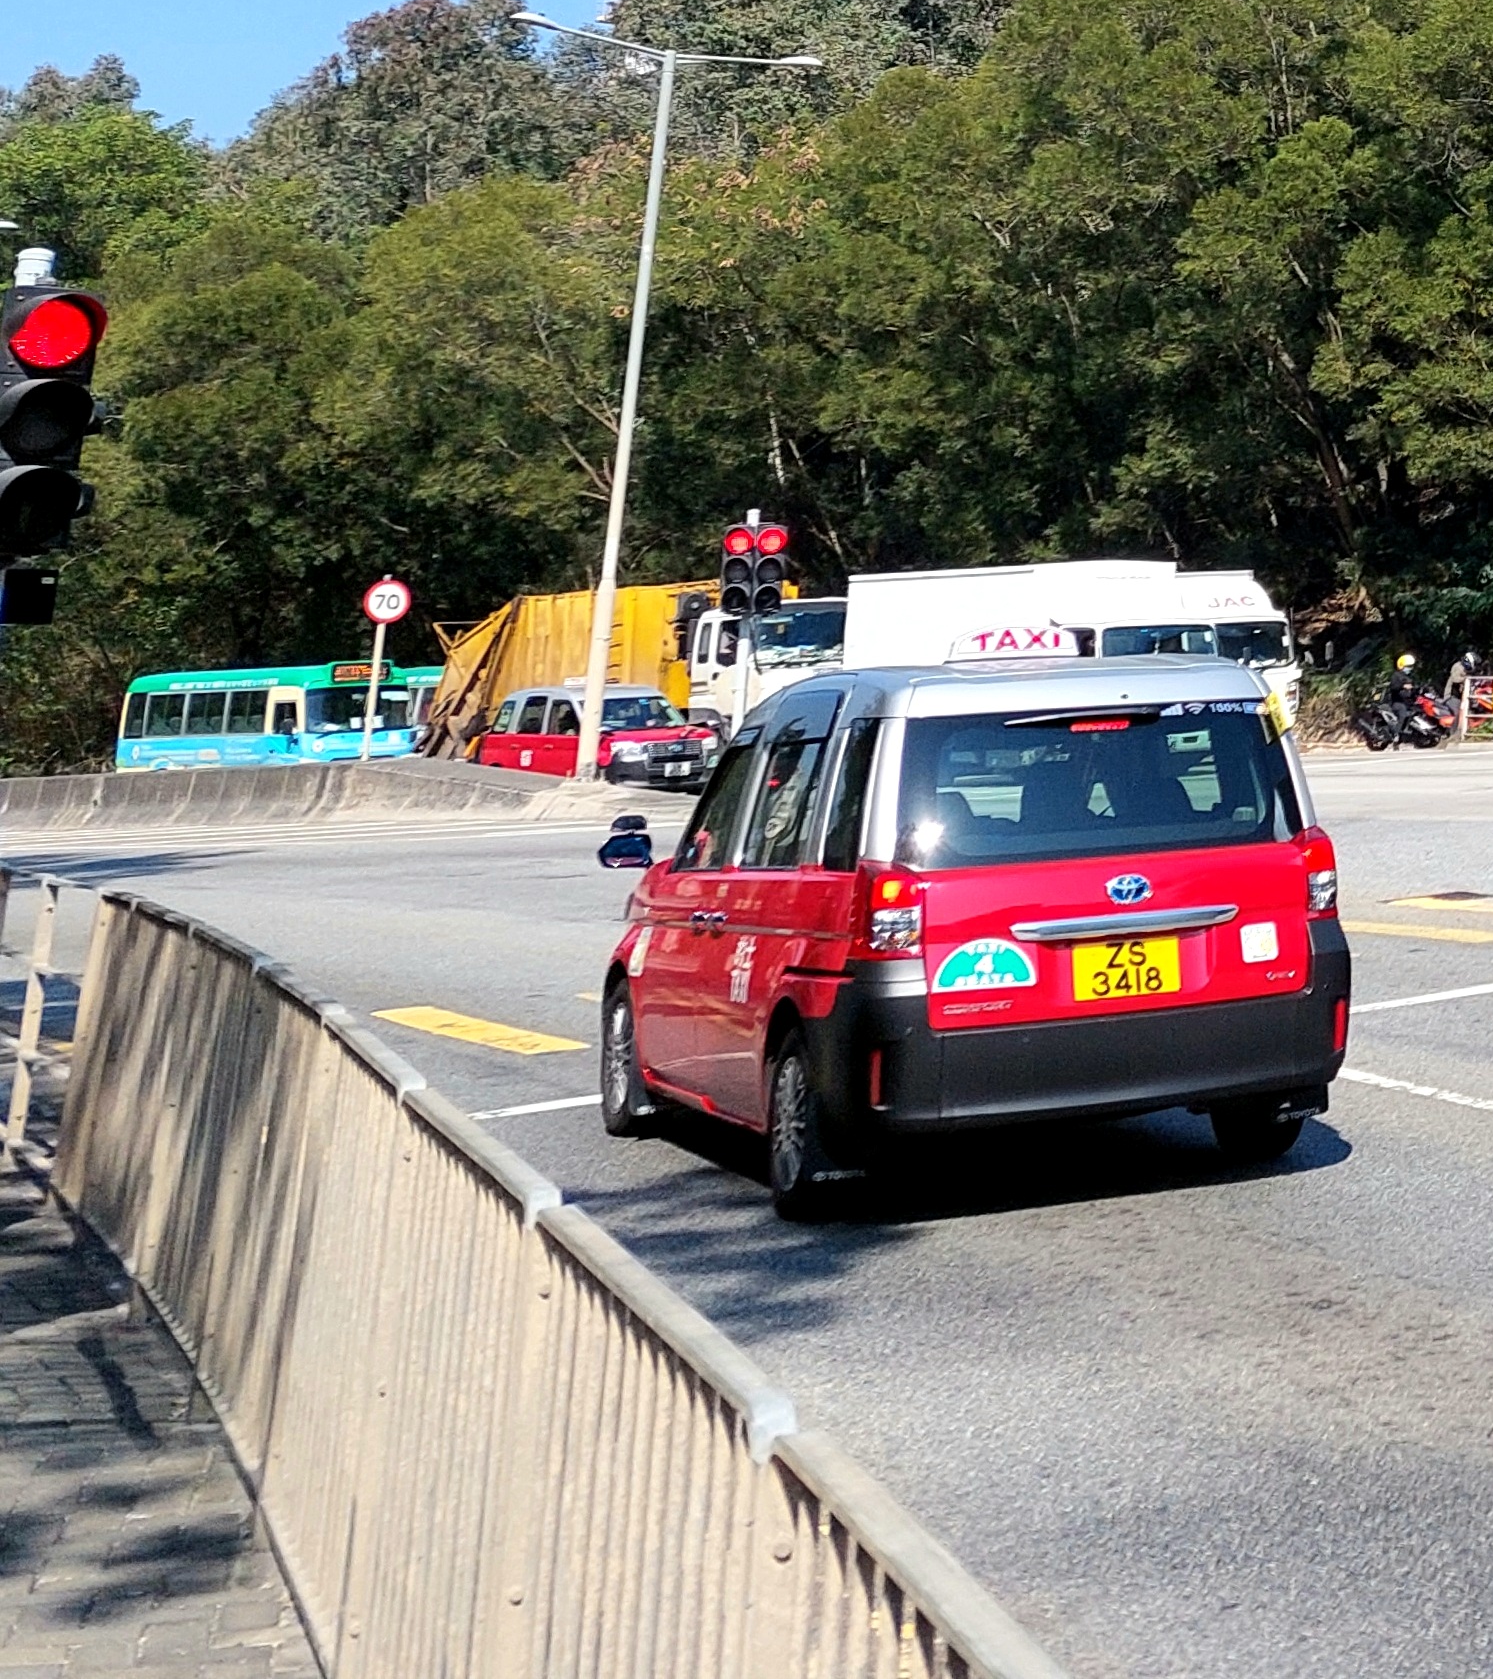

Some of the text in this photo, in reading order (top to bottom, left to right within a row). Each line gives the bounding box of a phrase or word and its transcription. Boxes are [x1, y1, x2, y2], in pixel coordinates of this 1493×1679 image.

[375, 594, 400, 610] 70
[1208, 595, 1256, 609] JAC
[971, 628, 1061, 652] TAXI
[1208, 702, 1243, 714] 100%
[974, 953, 995, 974] 4
[1105, 940, 1147, 970] ZS
[1091, 966, 1163, 997] 3418
